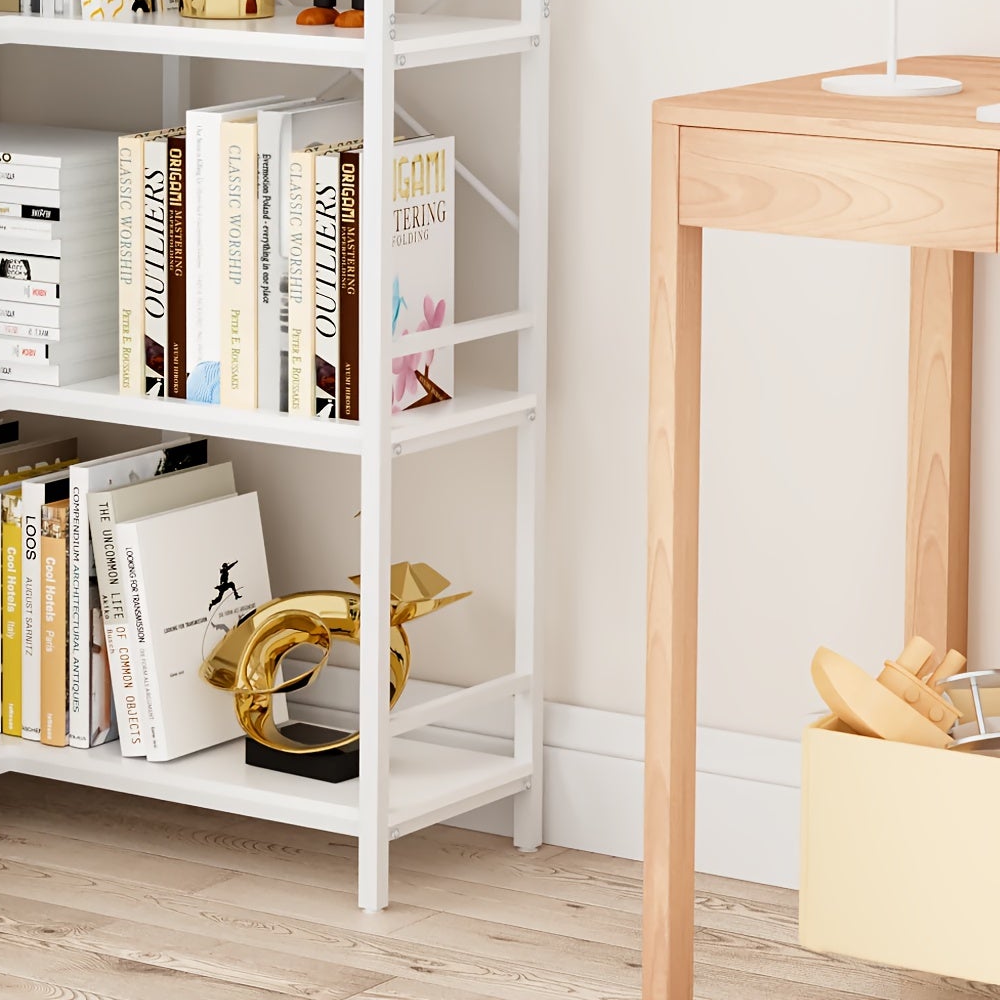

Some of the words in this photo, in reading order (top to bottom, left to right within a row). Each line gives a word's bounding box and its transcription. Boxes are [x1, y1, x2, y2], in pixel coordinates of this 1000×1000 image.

[119, 147, 132, 212] CLASSIC
[169, 148, 182, 207] ORIGAMI
[227, 144, 241, 208] CLASSIC
[261, 153, 271, 195] Evermotion
[289, 161, 303, 227] CLASSIC
[341, 162, 355, 223] ORIGAMI
[261, 195, 271, 220] Poland
[393, 200, 446, 233] TERING
[120, 216, 133, 286] WORSHIP
[144, 167, 165, 319] OUTLIERS
[174, 209, 183, 277] MASTERING
[228, 214, 242, 286] WORSHIP
[260, 225, 271, 262] everything
[315, 182, 337, 339] OUTLIERS
[346, 226, 355, 295] MASTERING
[289, 232, 303, 305] WORSHIP
[260, 286, 271, 304] place
[98, 502, 111, 523] THE
[6, 547, 16, 572] Cool
[26, 515, 37, 561] LOOS
[102, 529, 119, 586] UNCOMMON
[45, 556, 56, 583] Cool
[125, 547, 136, 579] LOOKING
[130, 579, 138, 593] FOR
[6, 574, 16, 614] Hotels
[25, 576, 33, 615] AUGUST
[45, 585, 55, 623] Hotels
[72, 563, 80, 654] ARCHITECTURAL
[110, 592, 125, 620] LIFE
[25, 617, 33, 657] SARNITZ
[116, 627, 127, 641] OF
[132, 593, 146, 644] TRANSMISSION
[72, 656, 80, 714] ANTIQUES
[118, 647, 134, 690] COMMON
[125, 695, 142, 745] OBJECTS
